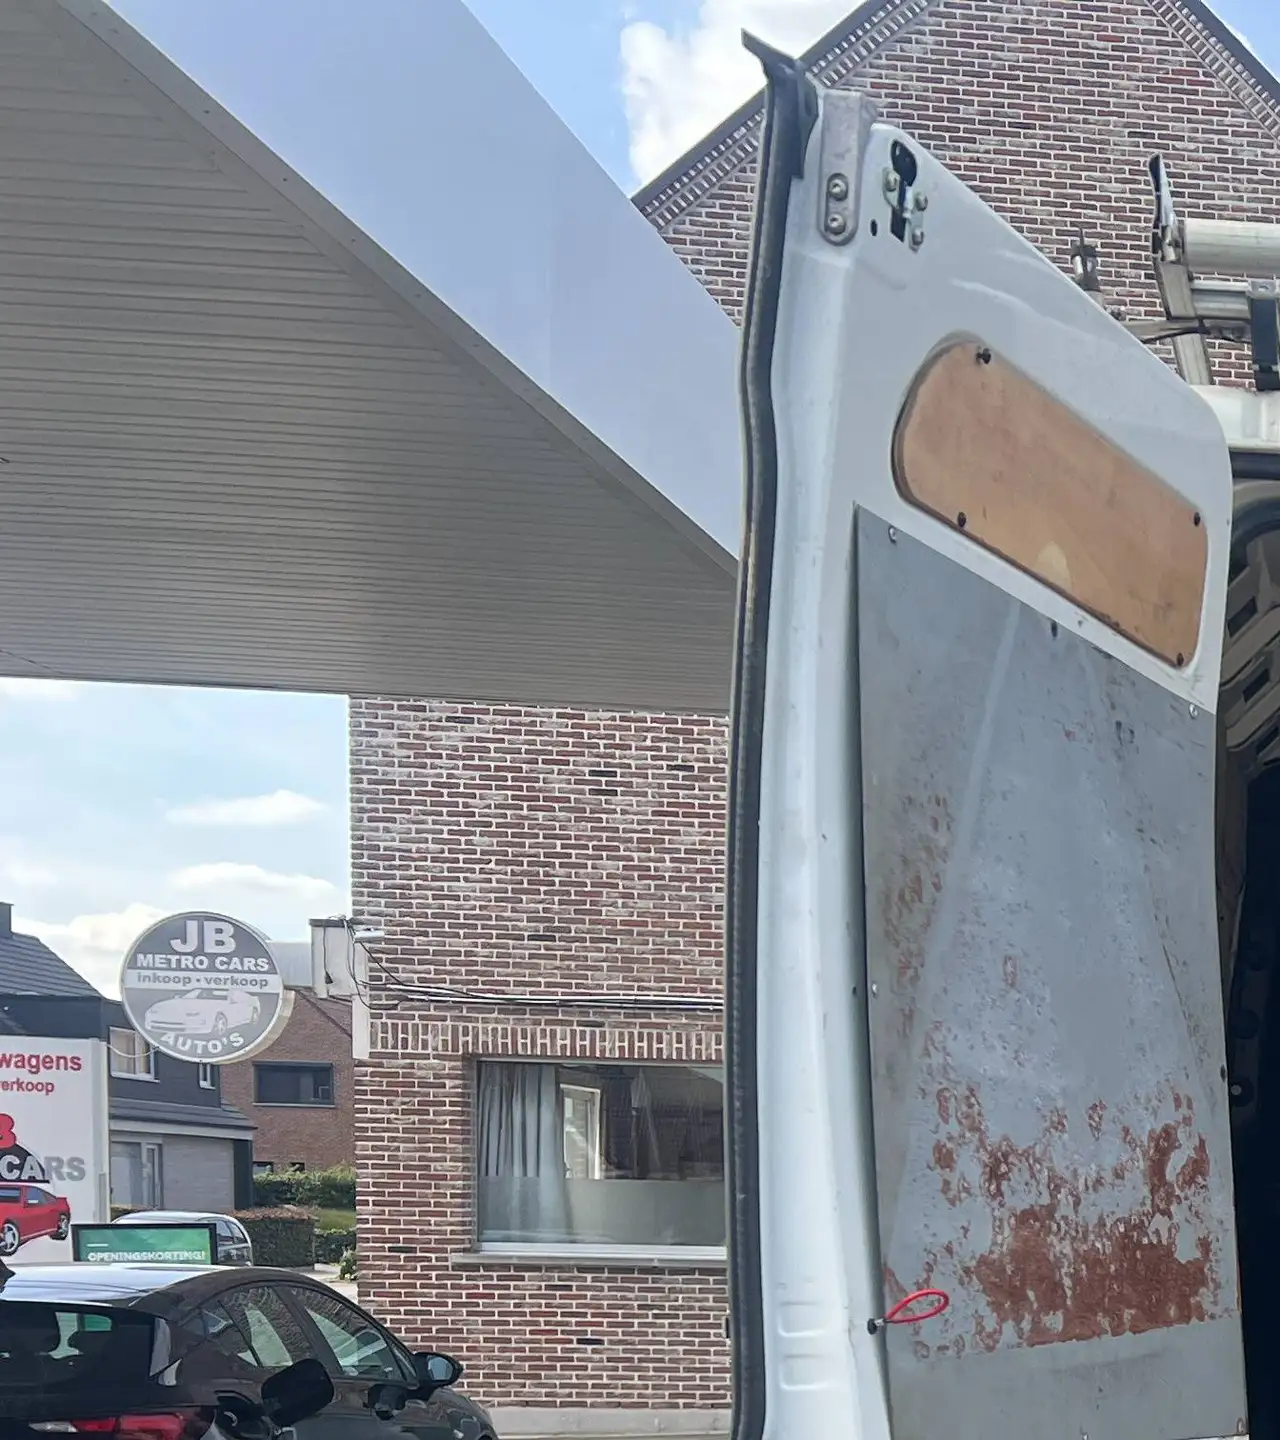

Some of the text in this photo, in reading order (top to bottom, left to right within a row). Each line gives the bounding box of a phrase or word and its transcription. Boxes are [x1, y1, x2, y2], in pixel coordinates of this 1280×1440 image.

[170, 920, 236, 953] JB
[136, 953, 269, 971] METRO CARS
[137, 972, 268, 989] inkoop verkoop
[160, 1032, 244, 1054] AUTO'S
[0, 1078, 55, 1095] erkoop
[1, 1154, 86, 1182] CARS
[87, 1250, 206, 1262] OPENINGSKORTING!
